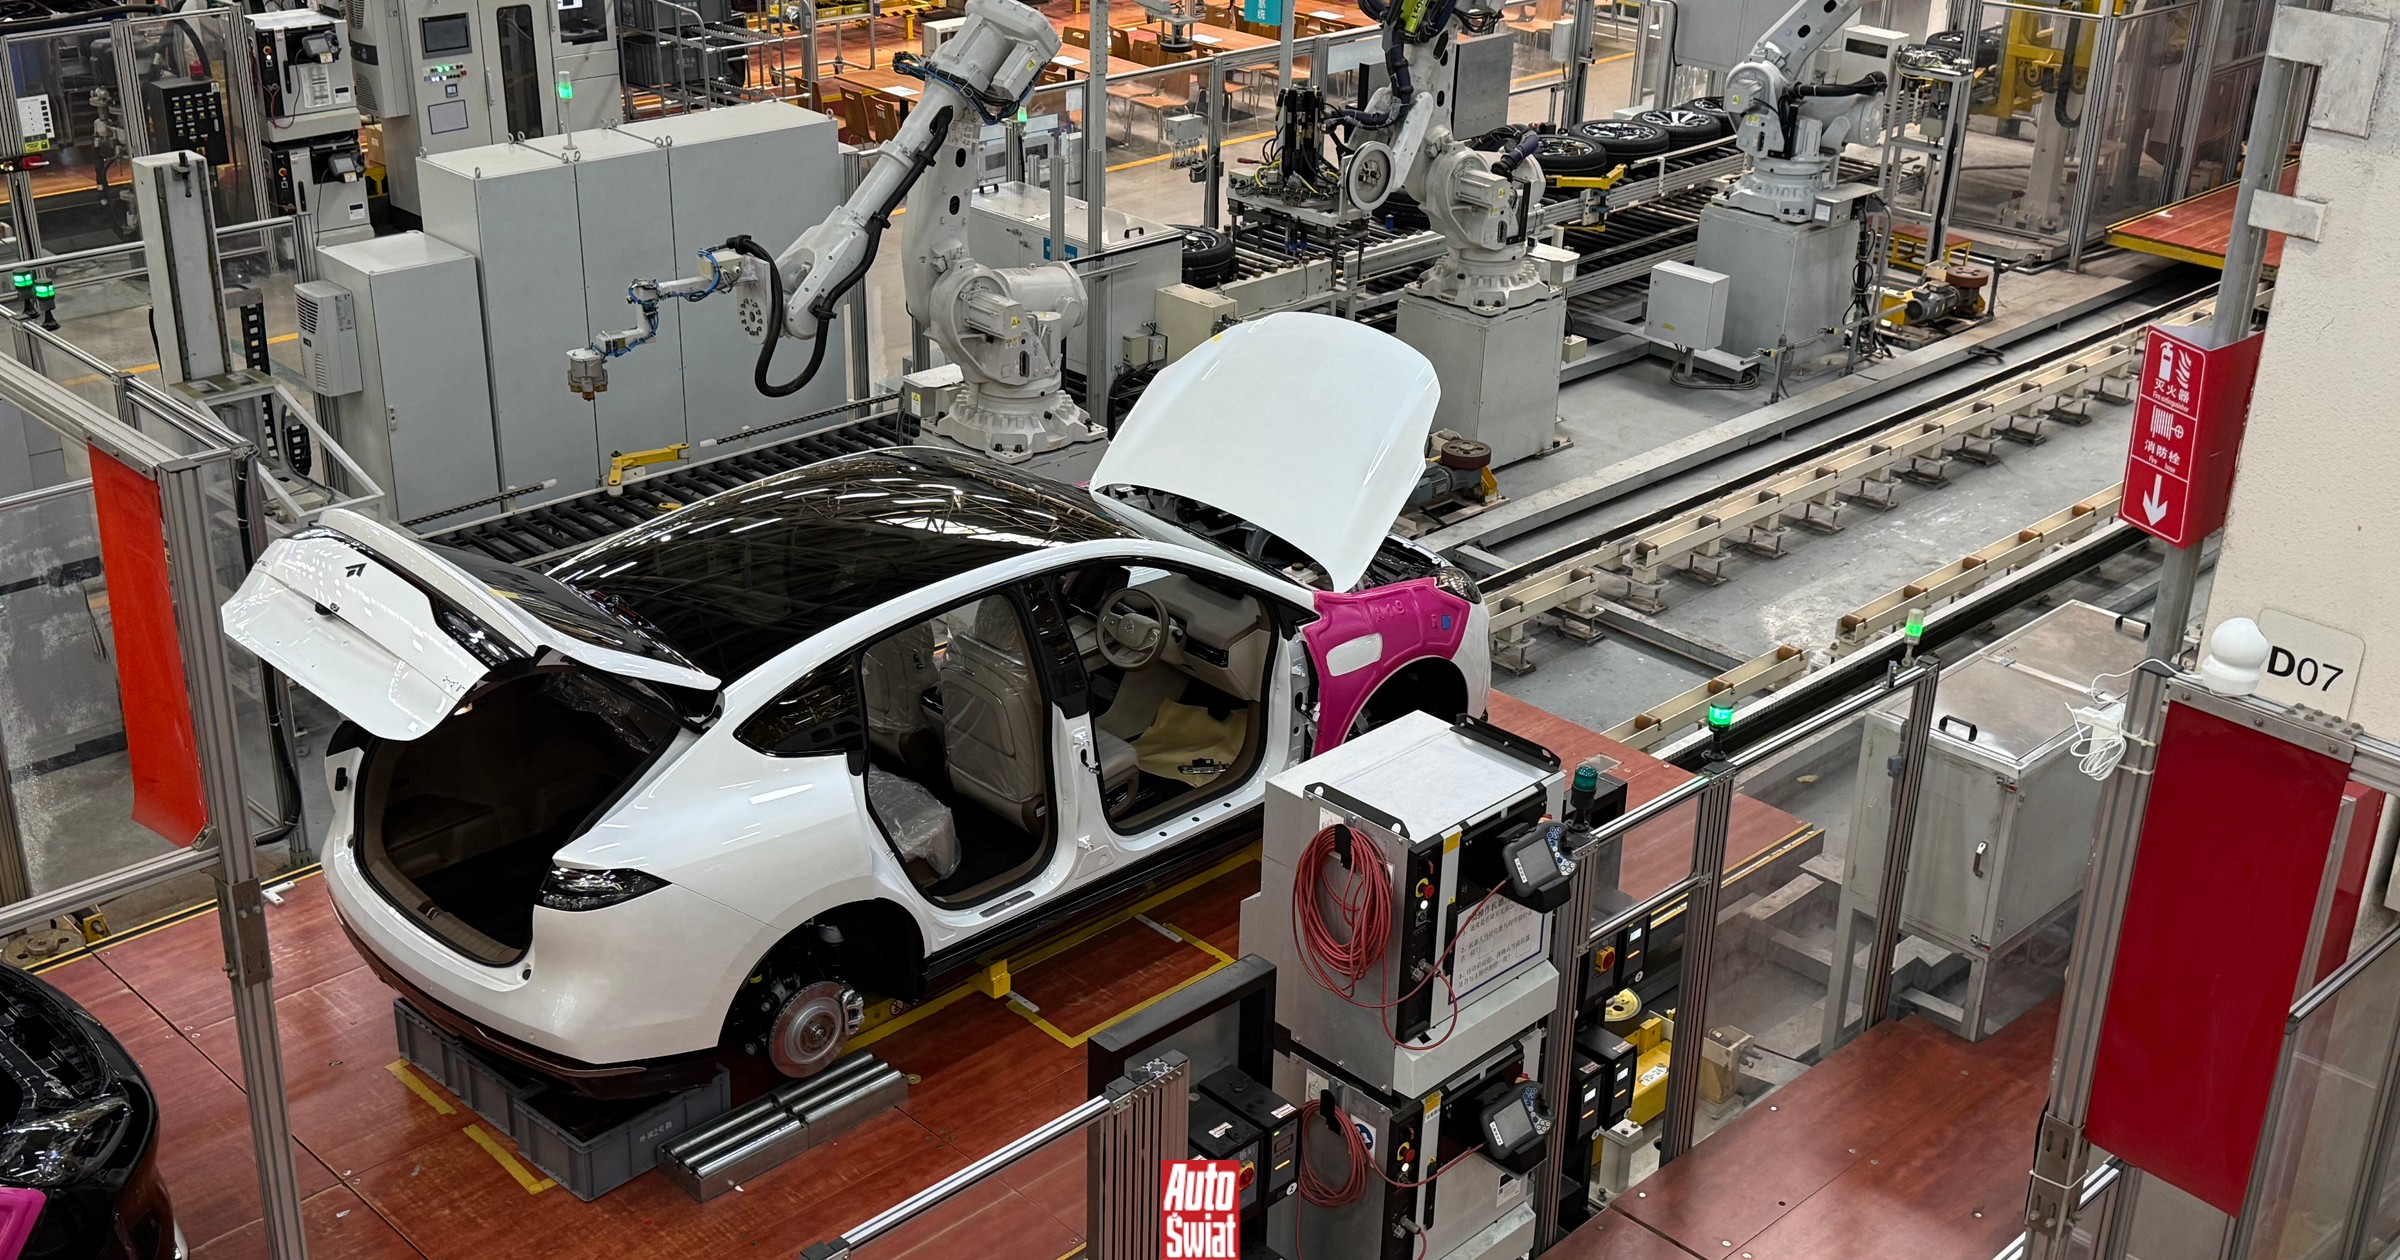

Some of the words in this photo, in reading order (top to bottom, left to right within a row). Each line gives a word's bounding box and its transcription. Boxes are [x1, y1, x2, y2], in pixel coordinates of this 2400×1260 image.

[1411, 0, 1424, 19] LEO
[2152, 390, 2161, 401] Fire
[2161, 396, 2190, 413] extinguisher
[2153, 377, 2191, 404] 灭火器
[2144, 439, 2181, 466] 消防栓
[2148, 455, 2158, 465] Fire
[2164, 462, 2176, 474] hose
[2267, 645, 2344, 692] D07
